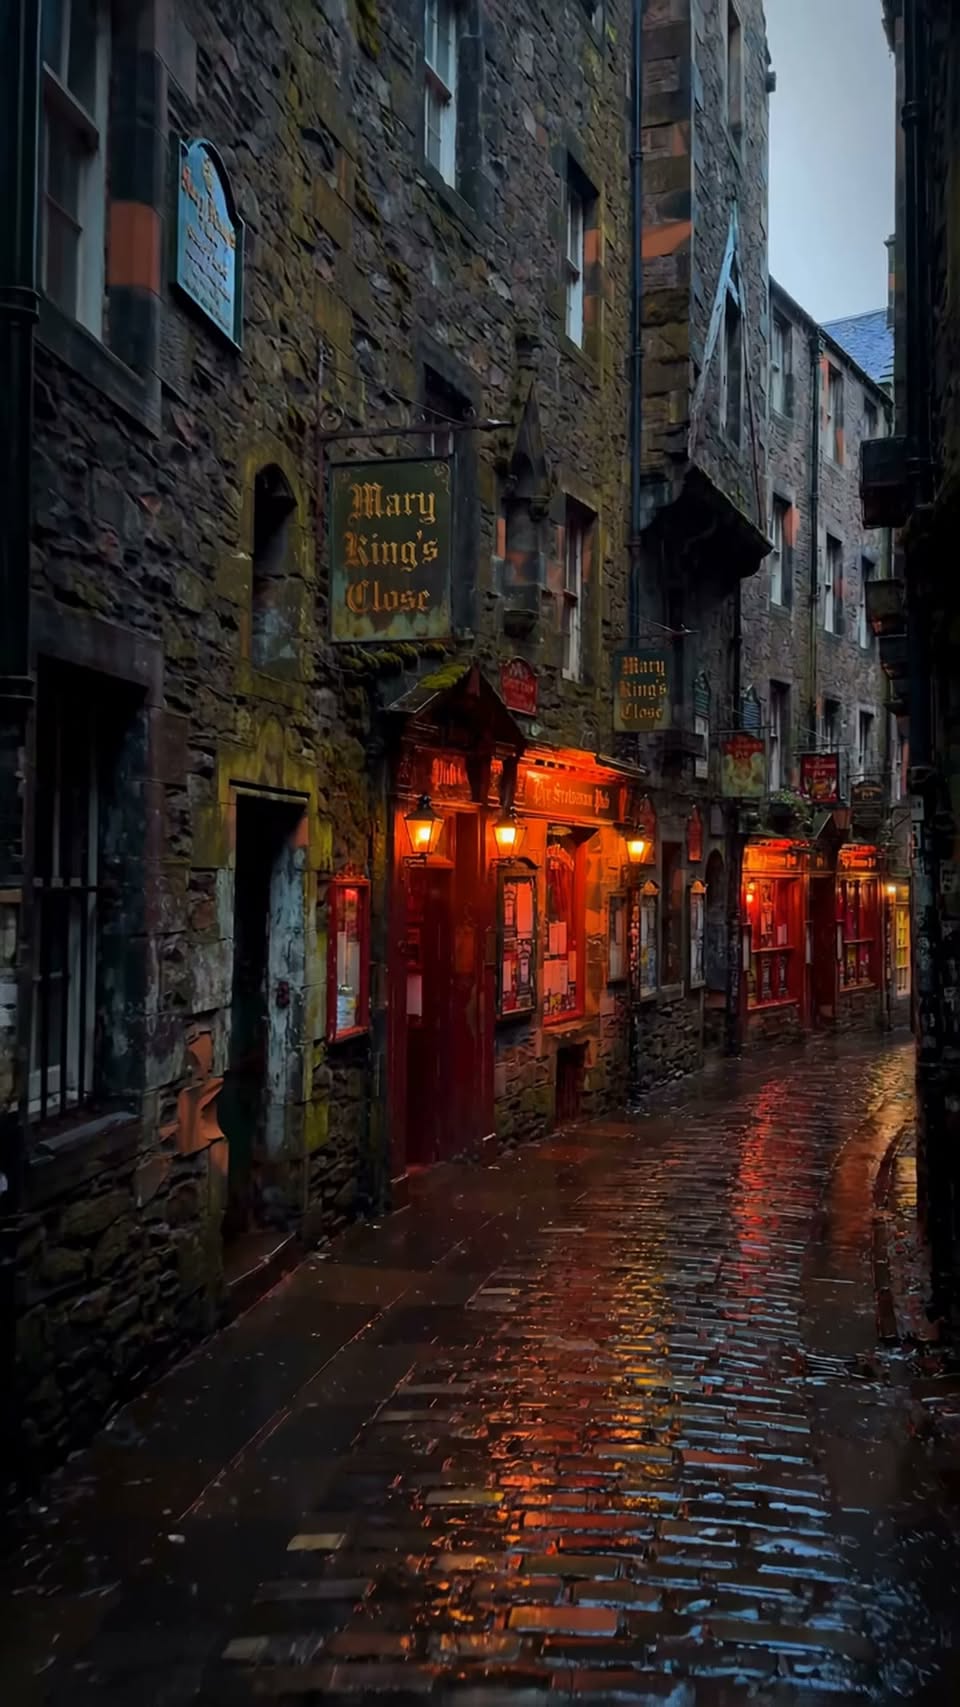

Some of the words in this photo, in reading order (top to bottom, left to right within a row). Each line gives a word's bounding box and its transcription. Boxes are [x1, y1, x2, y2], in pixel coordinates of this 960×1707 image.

[350, 482, 436, 523] Mary
[343, 530, 439, 572] King's
[346, 580, 431, 613] Close
[621, 656, 665, 676] Mary
[618, 679, 667, 700] King's
[620, 703, 664, 720] Close
